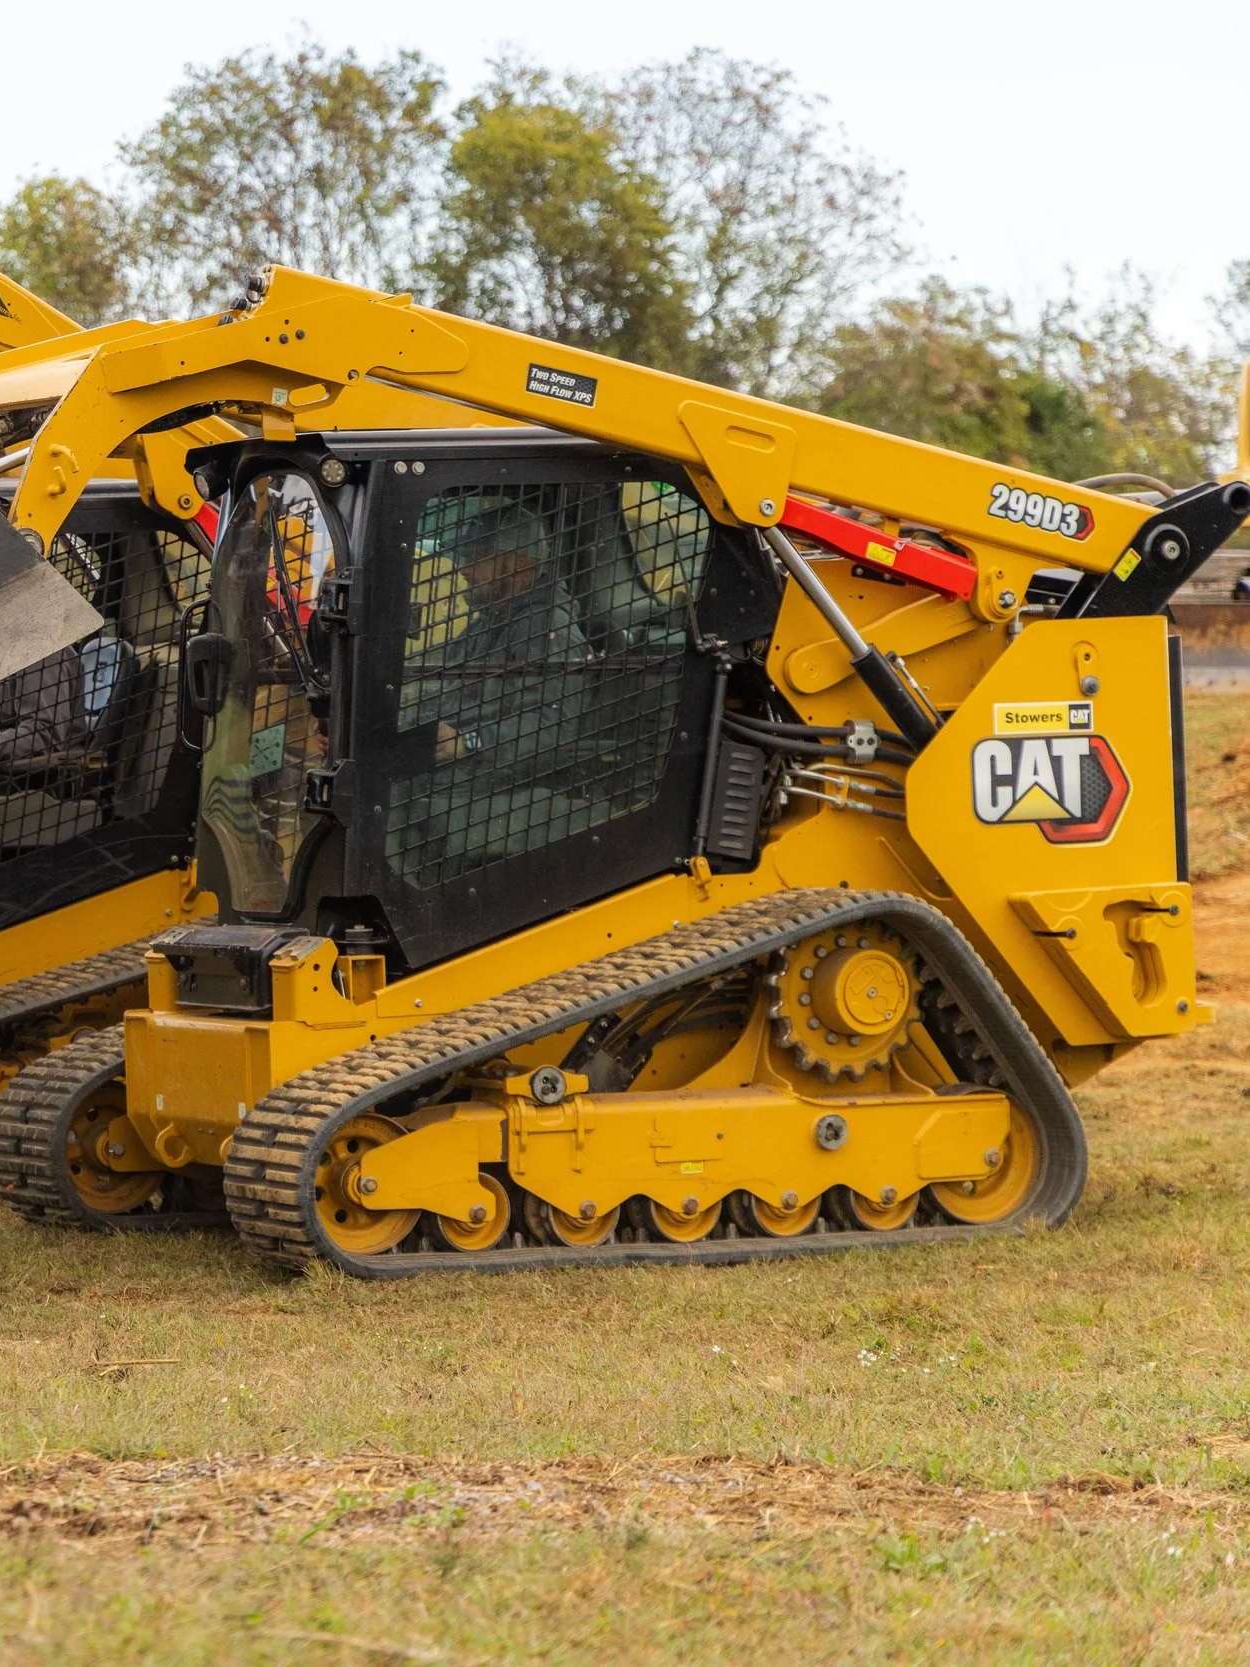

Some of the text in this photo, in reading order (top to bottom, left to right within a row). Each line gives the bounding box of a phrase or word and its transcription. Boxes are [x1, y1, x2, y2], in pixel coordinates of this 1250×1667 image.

[574, 391, 593, 404] XPS
[988, 483, 1080, 537] 299D3
[1005, 709, 1090, 724] Stowers CAT
[972, 737, 1090, 823] CAT
